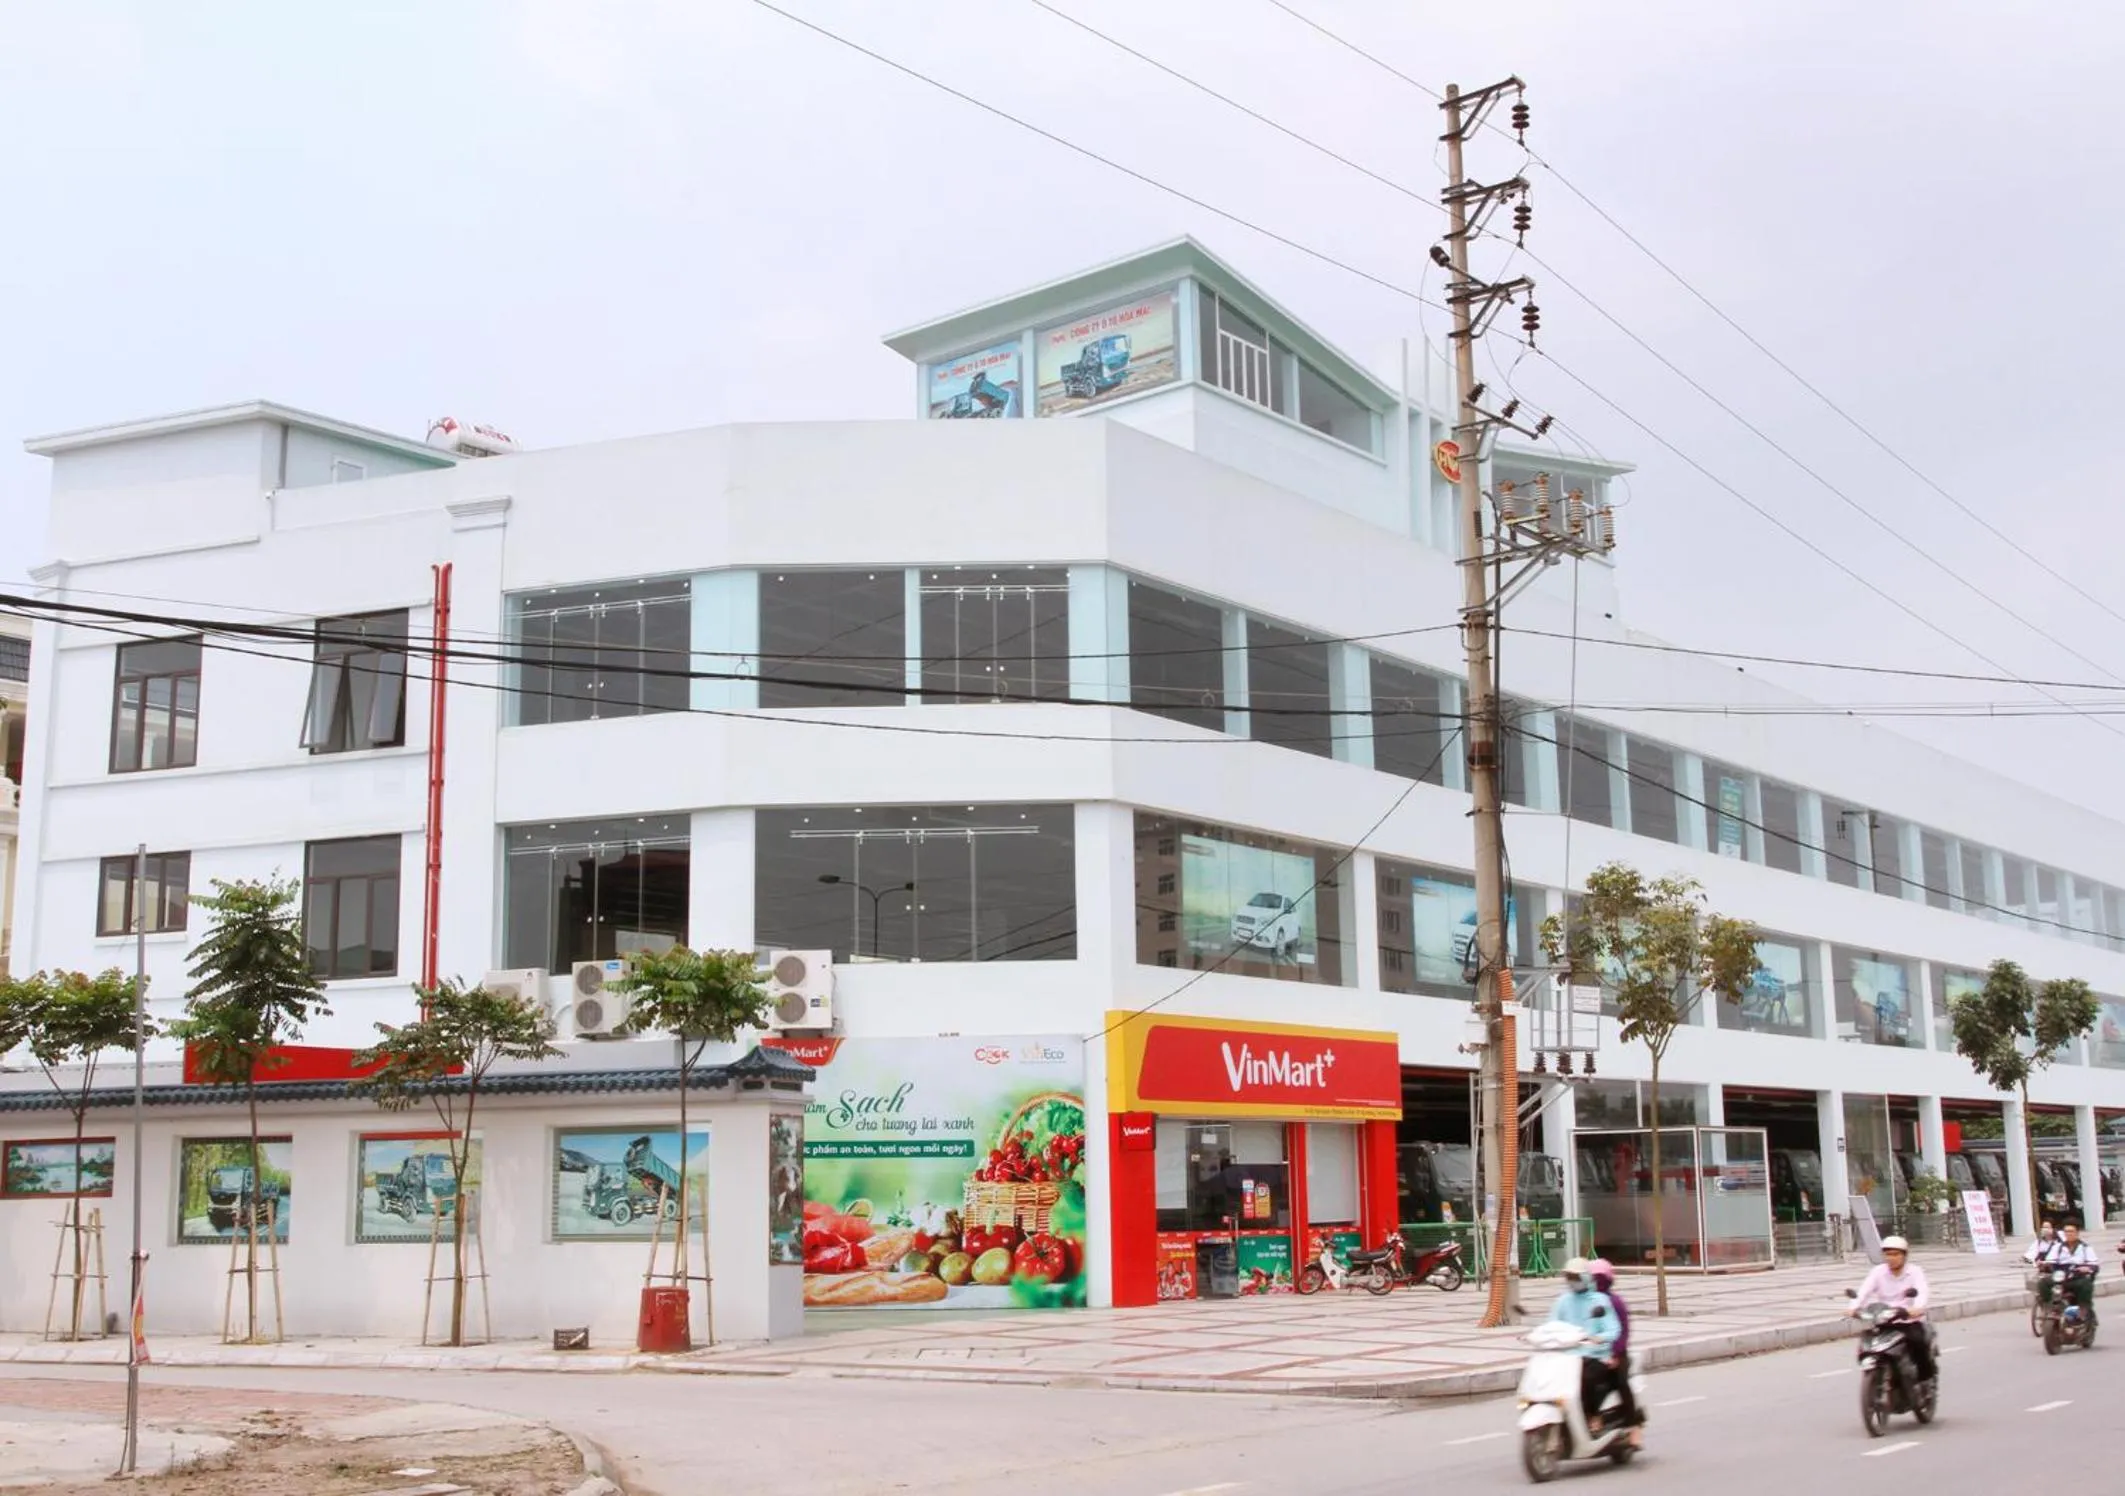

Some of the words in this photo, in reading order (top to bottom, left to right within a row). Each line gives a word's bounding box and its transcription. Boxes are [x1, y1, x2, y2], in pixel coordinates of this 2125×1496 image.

[1221, 1041, 1336, 1093] VinMart+
[855, 1118, 878, 1131] cho
[942, 1117, 975, 1131] xanh
